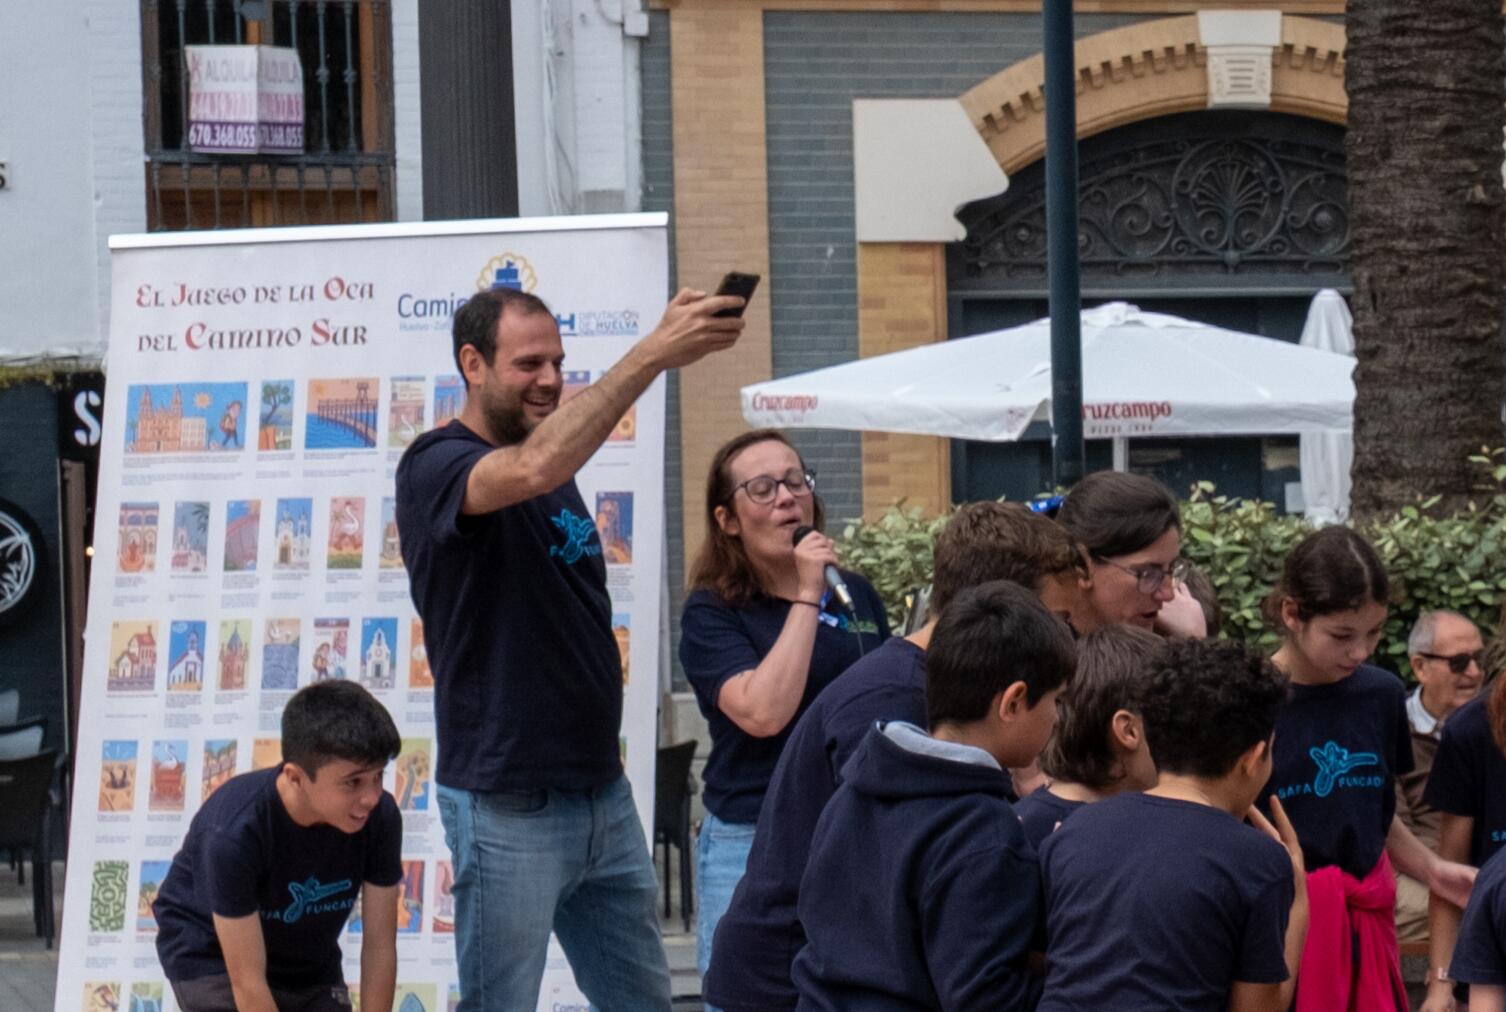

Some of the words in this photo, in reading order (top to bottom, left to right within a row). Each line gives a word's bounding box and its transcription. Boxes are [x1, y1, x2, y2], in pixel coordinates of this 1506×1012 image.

[189, 123, 256, 147] 670.368.055
[596, 320, 640, 331] HUELVA
[752, 392, 818, 413] Cruzcampo
[1081, 401, 1172, 422] ruzcampo
[1278, 783, 1312, 799] SAFA
